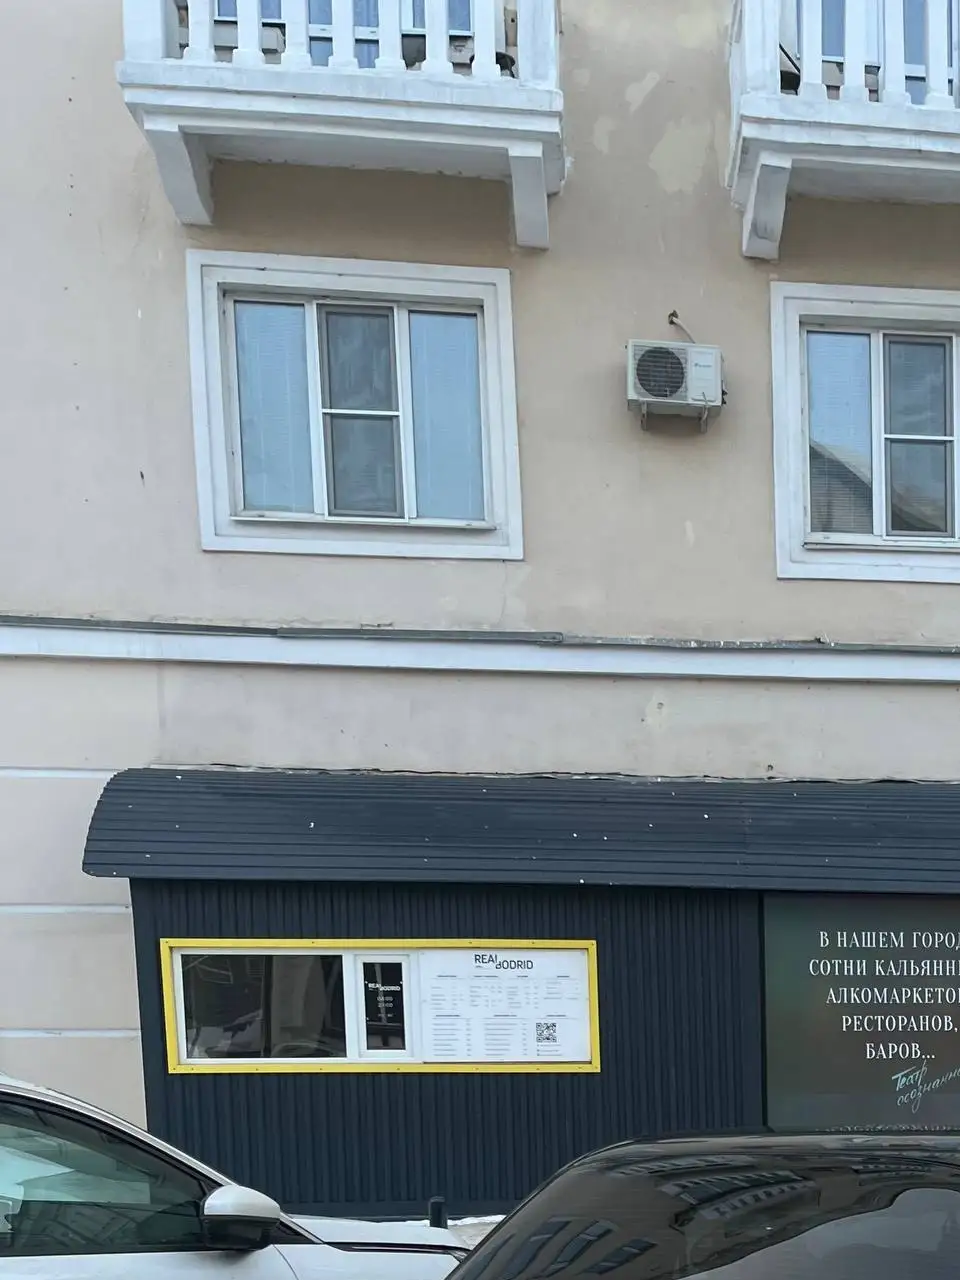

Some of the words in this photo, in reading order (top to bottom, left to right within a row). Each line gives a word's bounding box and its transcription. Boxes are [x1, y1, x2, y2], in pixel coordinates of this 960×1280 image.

[819, 931, 830, 949] В
[837, 931, 905, 949] НАШЕМ
[809, 959, 867, 976] СОТНИ
[842, 1015, 958, 1032] РЕСТОРАНОВ,
[866, 1042, 935, 1059] БАРОВ...
[892, 1059, 928, 1092] Театр
